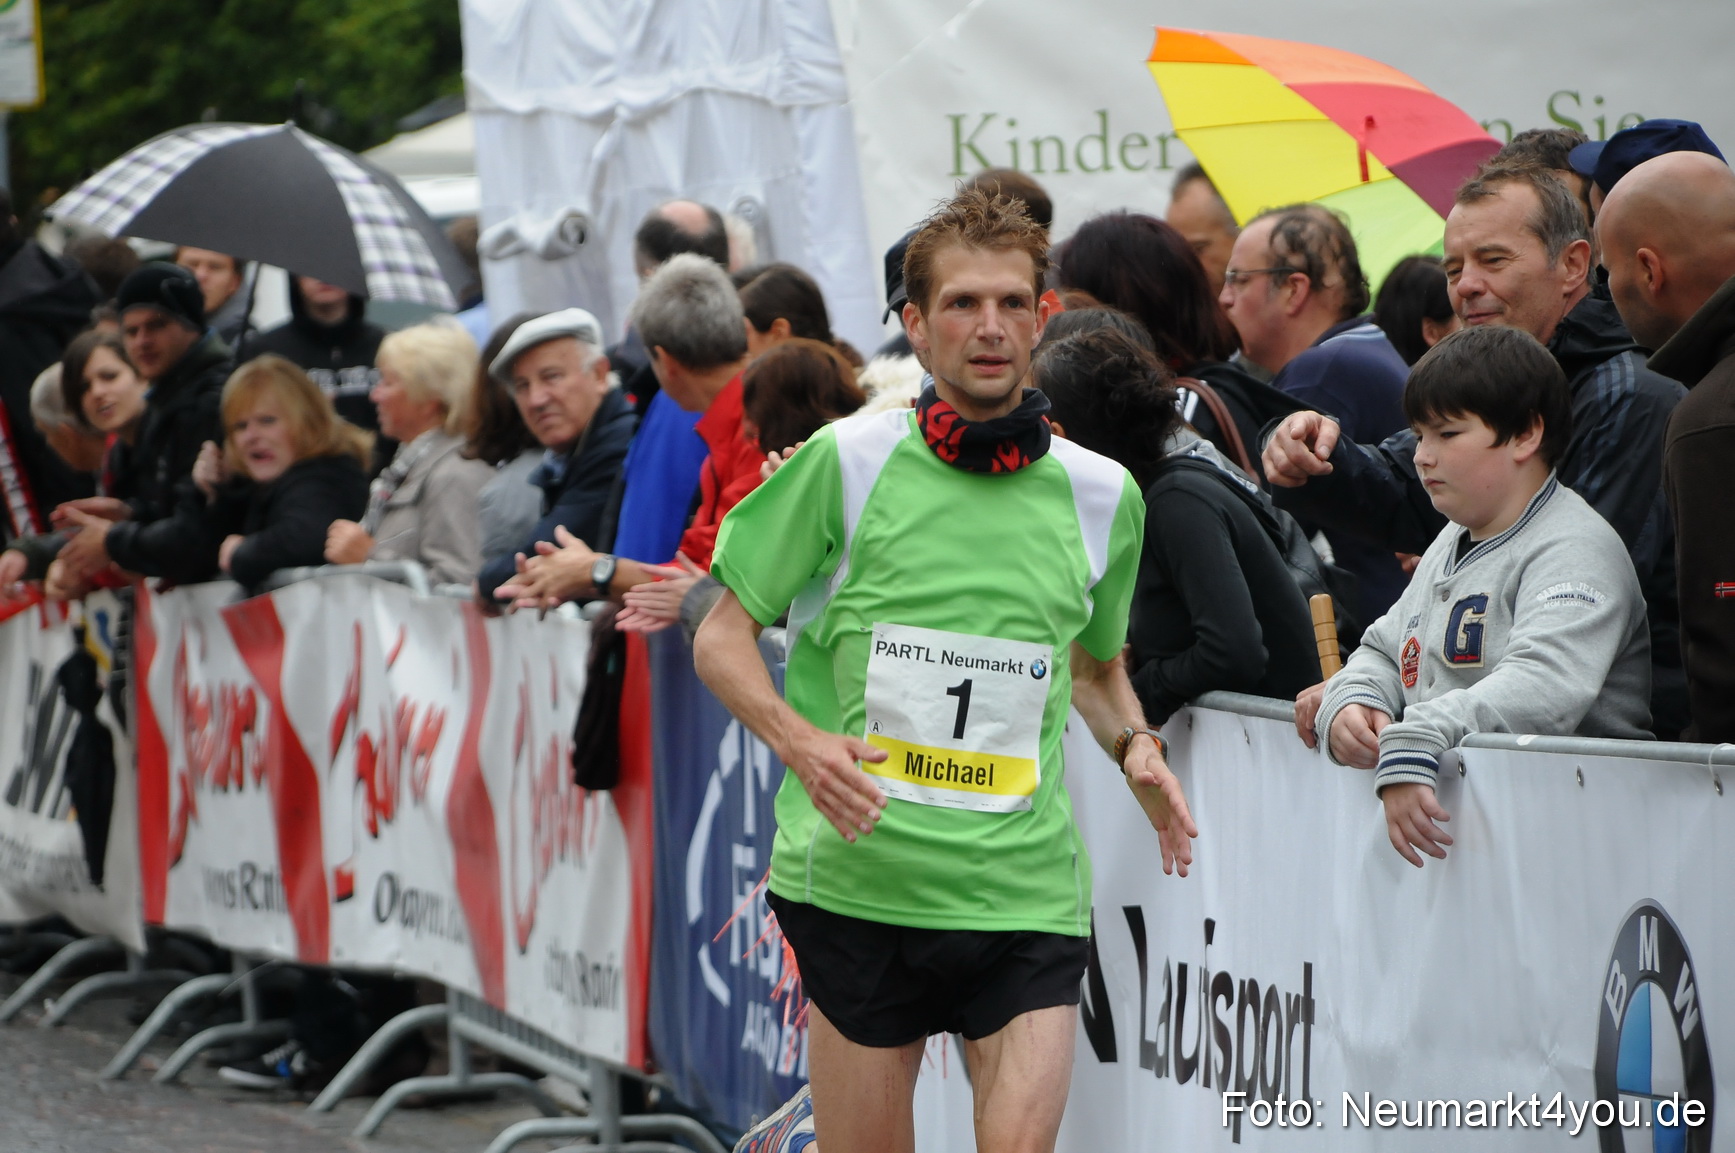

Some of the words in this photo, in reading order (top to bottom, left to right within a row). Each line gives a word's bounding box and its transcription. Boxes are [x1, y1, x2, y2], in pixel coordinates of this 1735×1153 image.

[945, 108, 1179, 177] Kinder
[1576, 582, 1607, 604] JEANS
[875, 640, 936, 663] PARTL
[940, 650, 1024, 675] Neumarkt
[1443, 593, 1490, 665] G
[946, 678, 973, 740] 1
[904, 751, 995, 787] Michael
[1605, 914, 1699, 1041] BMW
